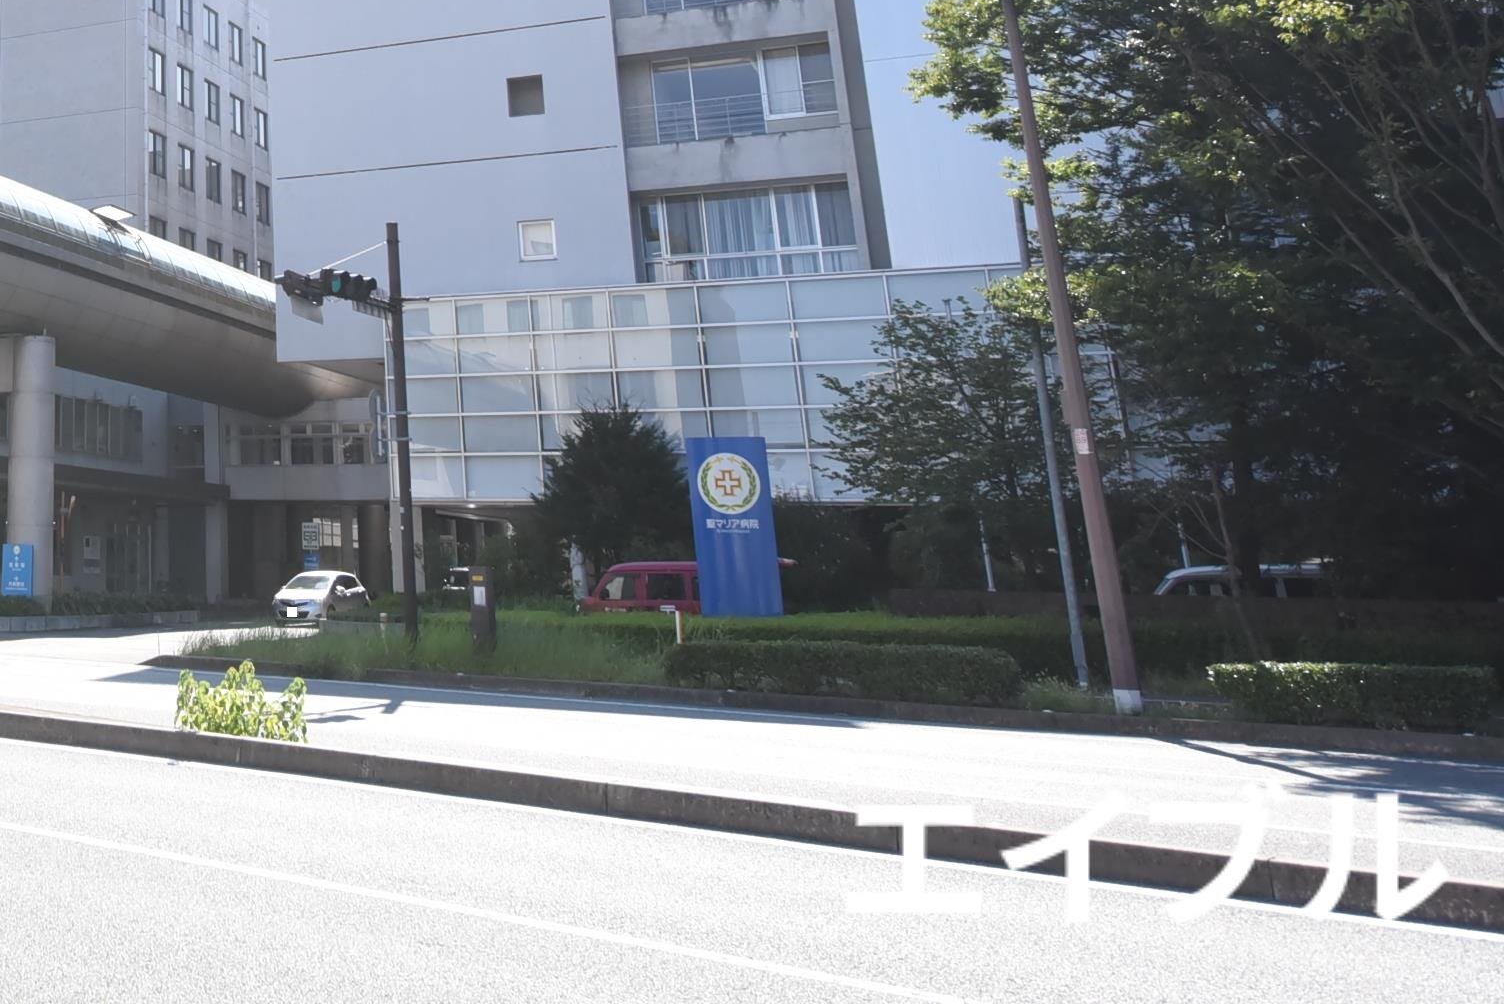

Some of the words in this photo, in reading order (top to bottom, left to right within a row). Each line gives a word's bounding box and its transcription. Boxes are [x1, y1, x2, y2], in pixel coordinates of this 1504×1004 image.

[706, 518, 760, 530] 聖マリア病院
